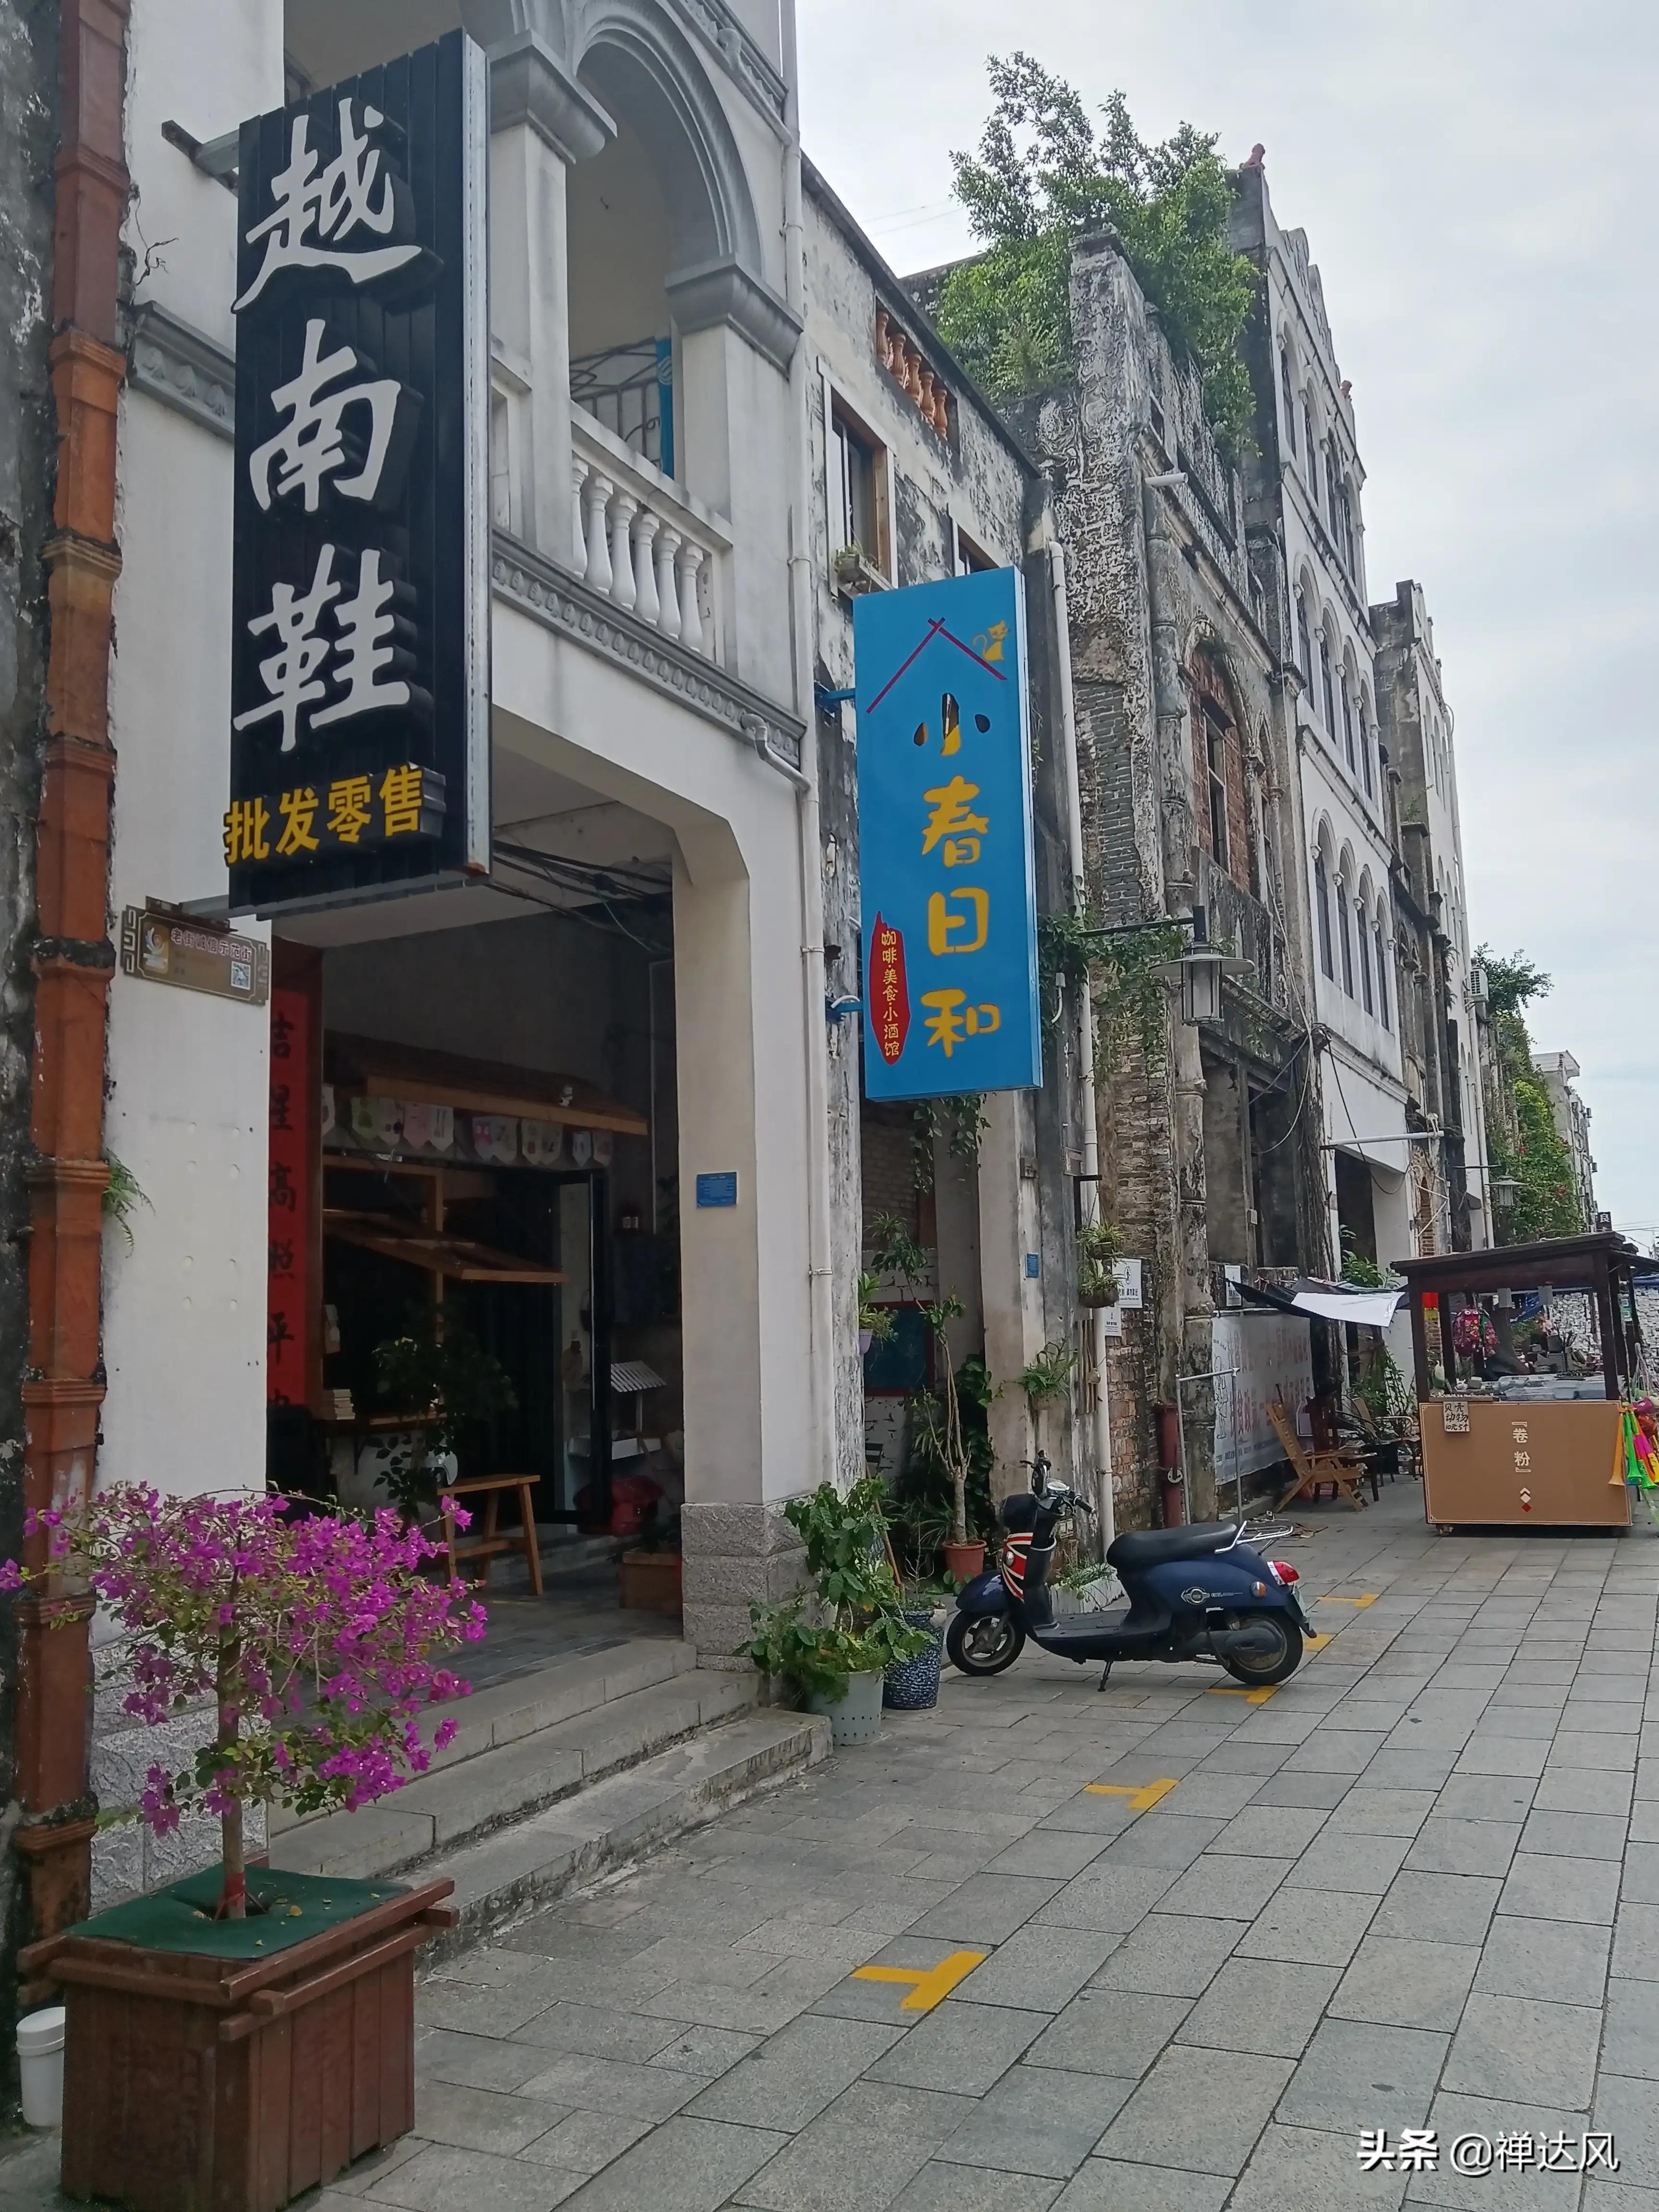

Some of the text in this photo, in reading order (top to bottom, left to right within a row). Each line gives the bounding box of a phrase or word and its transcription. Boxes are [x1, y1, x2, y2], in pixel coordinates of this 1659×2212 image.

[231, 97, 422, 752] 越南鞋
[225, 765, 425, 864] 批发零售
[913, 692, 1000, 1058] 小春日和
[171, 927, 252, 962] 老街诚信示范街
[1445, 1412, 1469, 1422] 动物
